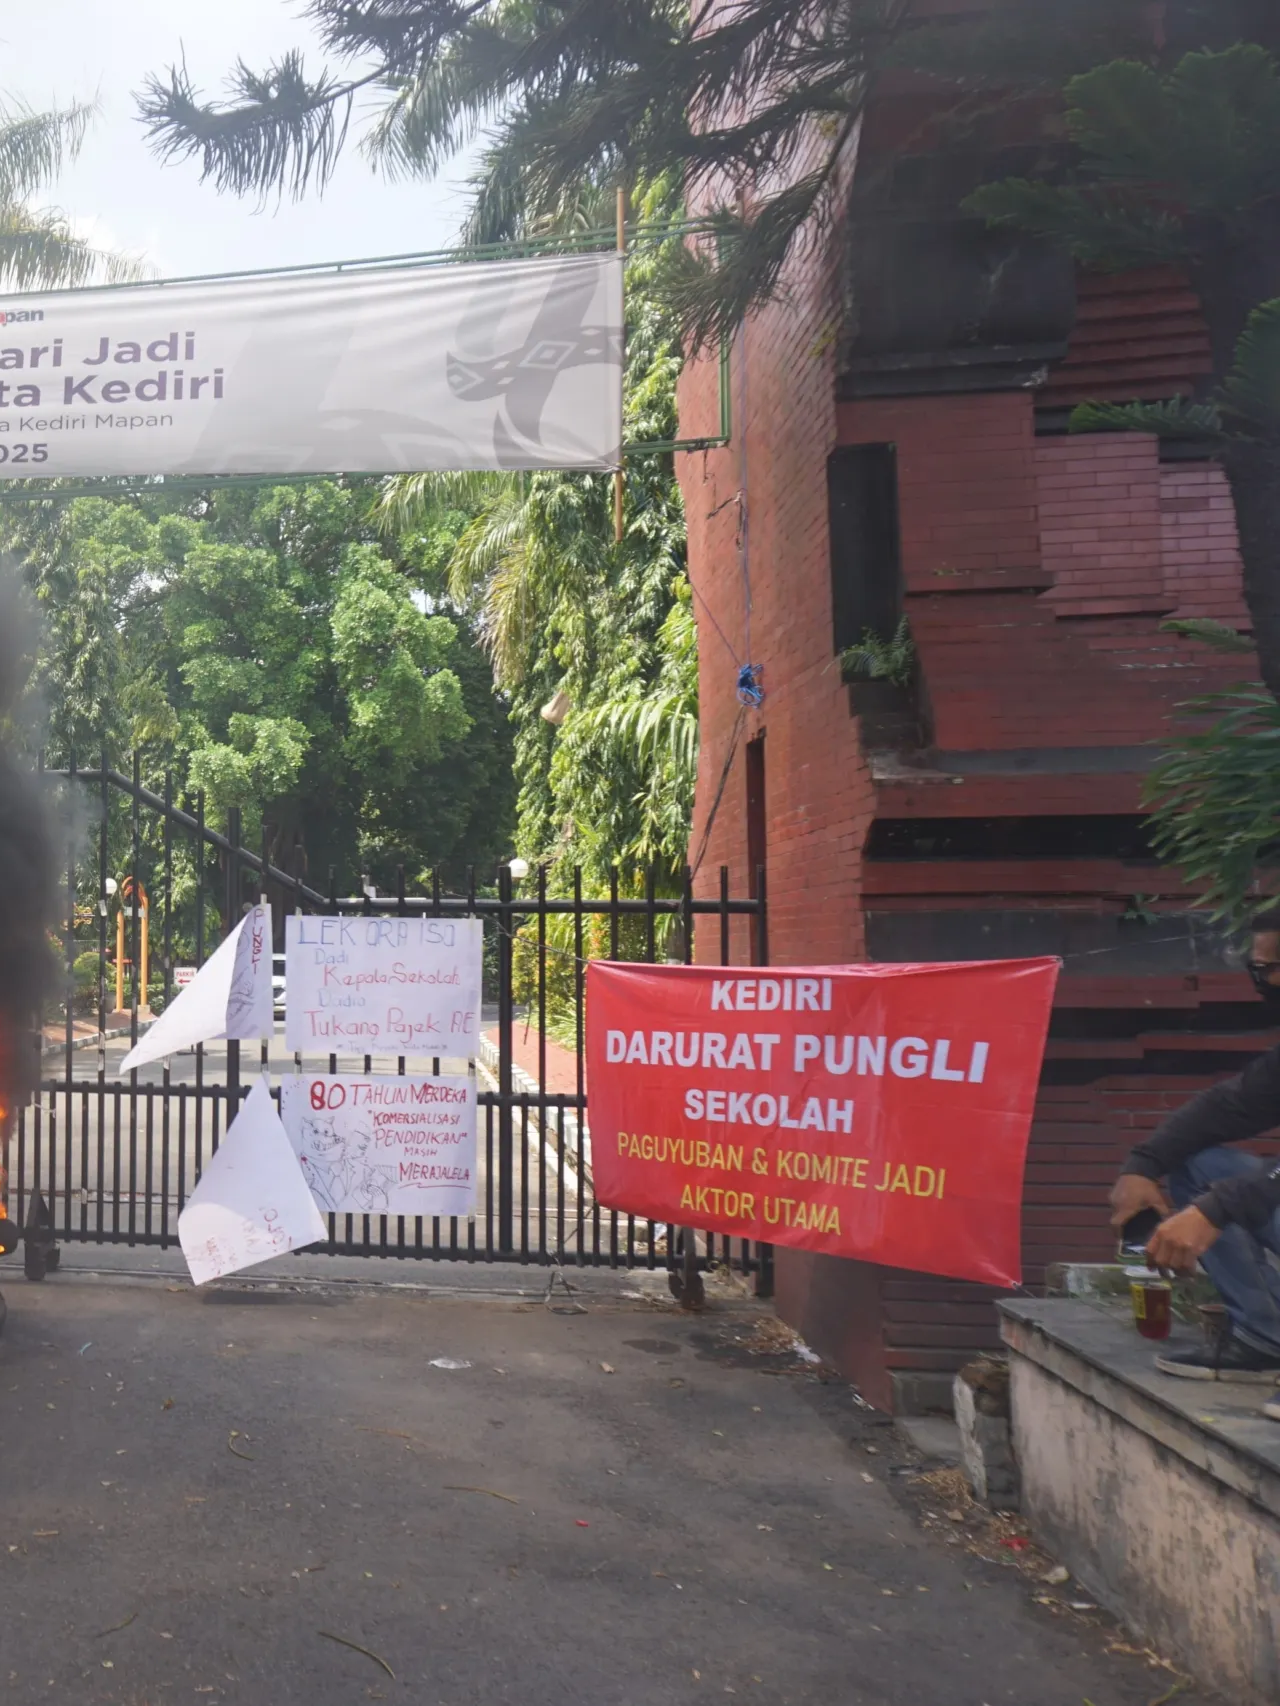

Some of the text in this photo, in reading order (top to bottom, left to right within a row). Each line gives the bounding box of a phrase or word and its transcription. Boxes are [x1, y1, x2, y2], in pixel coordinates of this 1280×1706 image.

[82, 331, 195, 368] Jadi
[63, 367, 225, 405] Kediri
[19, 414, 86, 432] Kediri
[95, 412, 173, 430] Mapan
[297, 919, 357, 946] LEK
[315, 948, 348, 965] Dadi
[388, 962, 461, 986] Sekolah
[710, 977, 833, 1012] KEDIRI
[304, 1010, 380, 1041] Tukang
[605, 1029, 990, 1084] DARURAT PUNGLI
[310, 1080, 468, 1111] 80 TAHUN MERDEKA
[684, 1088, 854, 1133] SEKOLAH
[404, 1147, 438, 1157] MASIH
[617, 1131, 946, 1200] PAGUYUBAN & KOMITE JADI
[398, 1161, 471, 1182] MERAJALELA
[680, 1184, 842, 1236] AKTOR UTAMA
